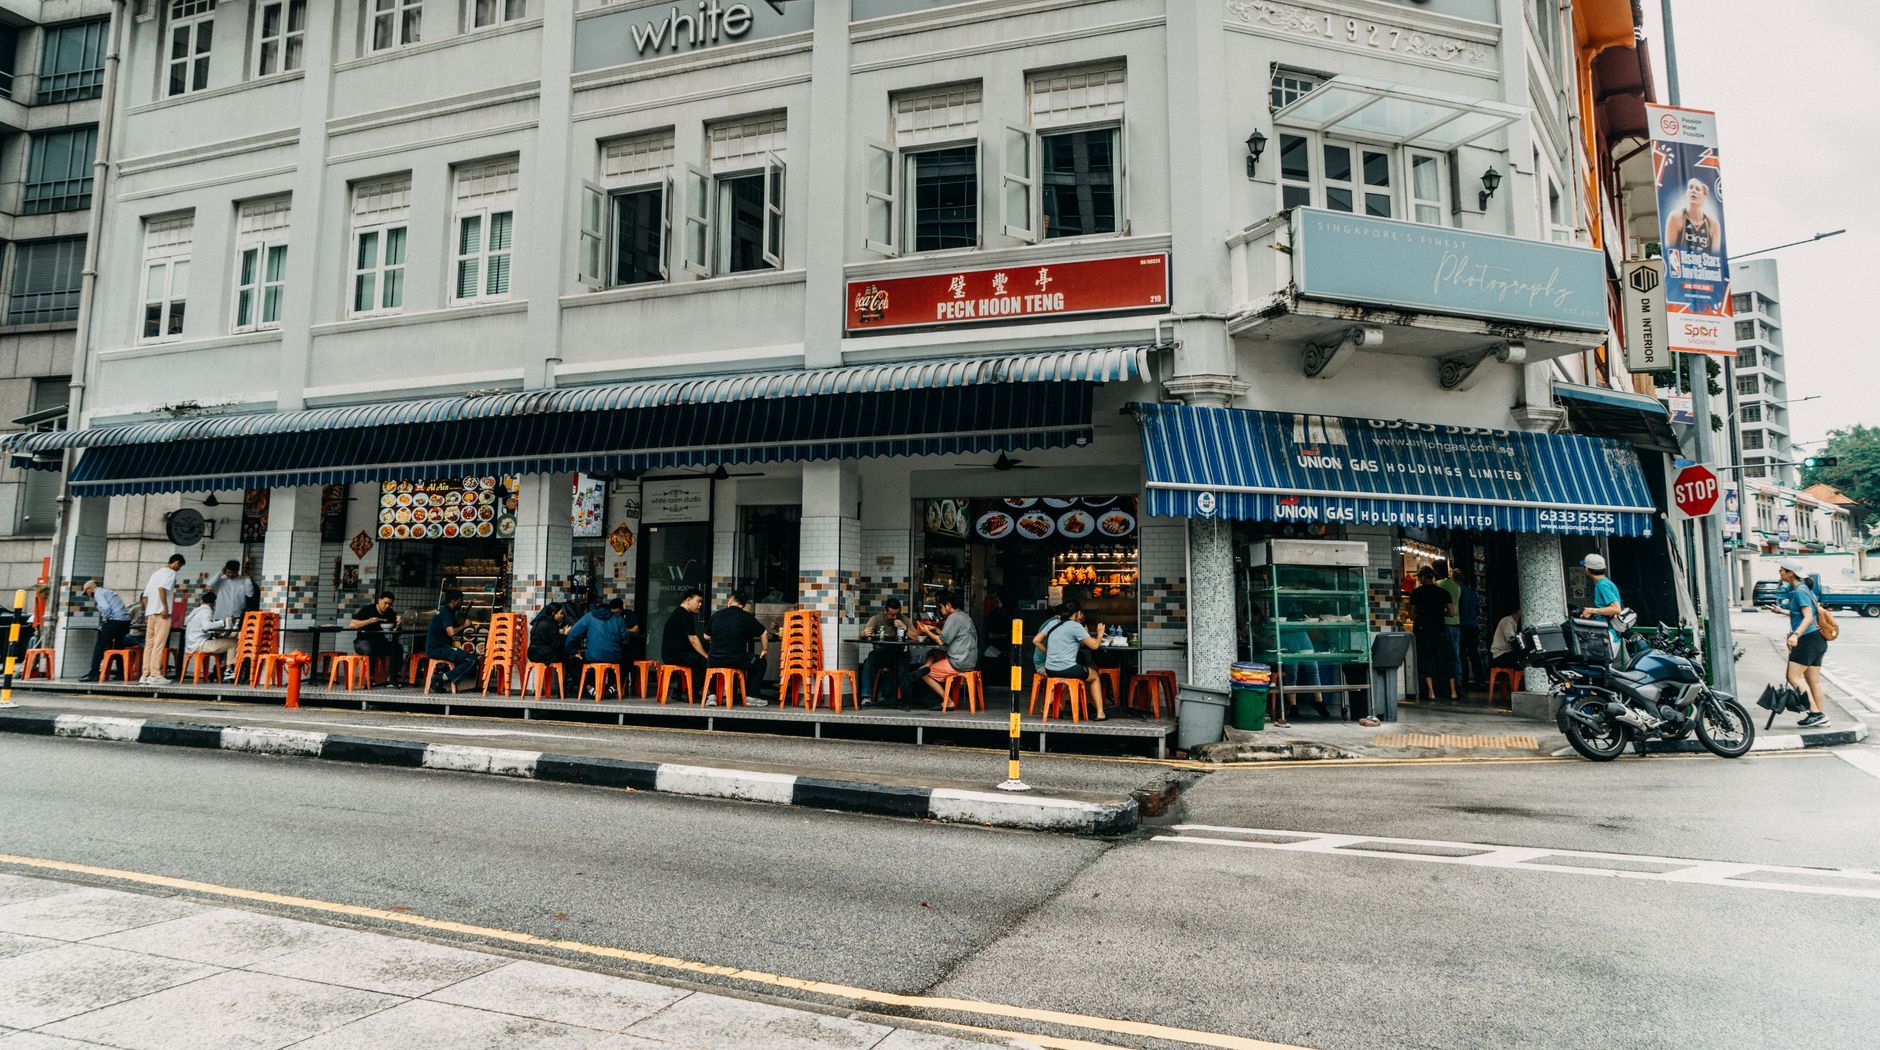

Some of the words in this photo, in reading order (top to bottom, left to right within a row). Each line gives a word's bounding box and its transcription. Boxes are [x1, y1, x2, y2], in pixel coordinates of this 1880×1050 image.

[629, 0, 754, 55] white
[1323, 13, 1401, 50] 1927
[1663, 119, 1677, 130] SG
[1317, 221, 1413, 242] SINGAPORE'S
[1420, 234, 1467, 250] FINEST
[1685, 232, 1708, 248] bing
[1680, 250, 1702, 267] Rising
[1702, 252, 1721, 267] Stars
[1433, 250, 1573, 308] Photography
[1682, 265, 1722, 282] Invitational
[936, 299, 976, 320] PECK
[978, 296, 1022, 317] HOON
[1024, 292, 1065, 313] TENG
[1640, 298, 1650, 314] DM
[1642, 317, 1654, 364] INTERIOR
[1684, 323, 1718, 338] Sport
[1297, 455, 1343, 471] UNION
[1350, 458, 1379, 473] GAS
[1386, 463, 1463, 478] HOLDINGS
[1468, 468, 1522, 481] LIMITED
[1675, 478, 1716, 504] STOP
[1274, 505, 1318, 519] UNION
[1326, 507, 1354, 521] GAS
[1361, 510, 1434, 524] HOLDINGS
[1440, 514, 1493, 526] LIMITED
[1539, 510, 1577, 522] 6333
[1578, 512, 1615, 525] 5555
[1540, 523, 1615, 534] www.uniongas.com.sg
